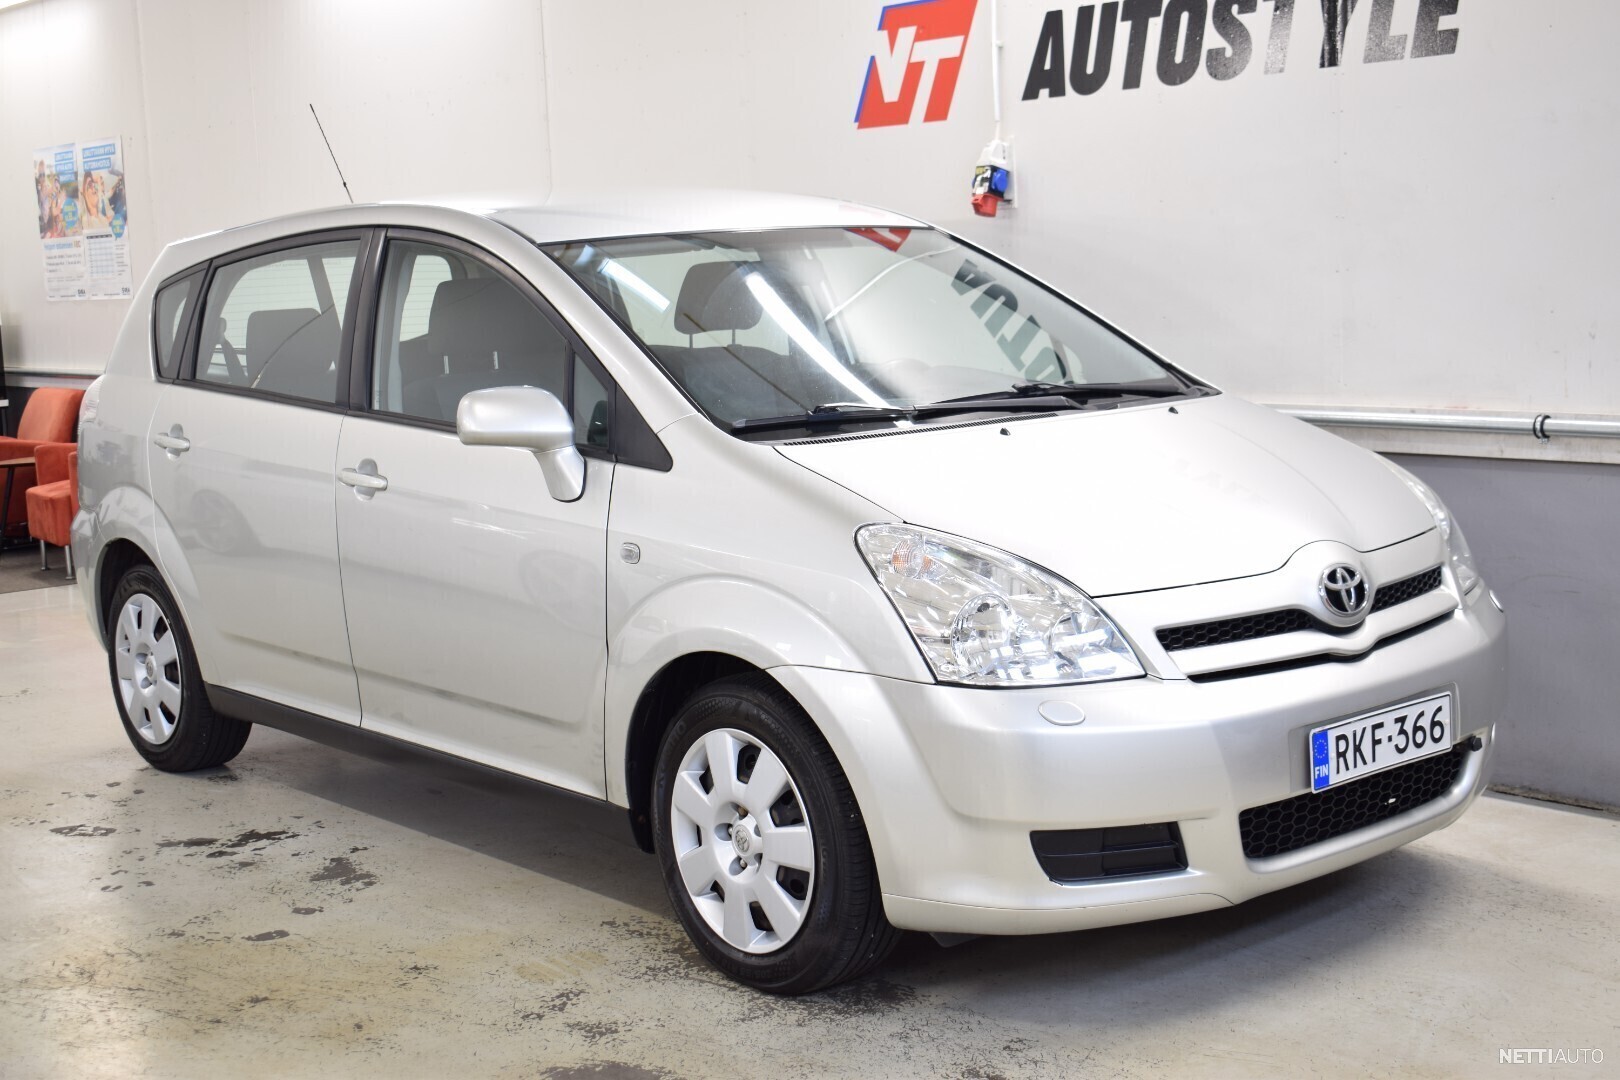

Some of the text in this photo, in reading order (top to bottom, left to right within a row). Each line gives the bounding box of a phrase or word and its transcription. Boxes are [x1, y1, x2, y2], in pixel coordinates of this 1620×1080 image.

[1022, 0, 1460, 102] AUTOSTYLE
[1314, 763, 1329, 779] FIN
[1335, 705, 1446, 774] RKF-366
